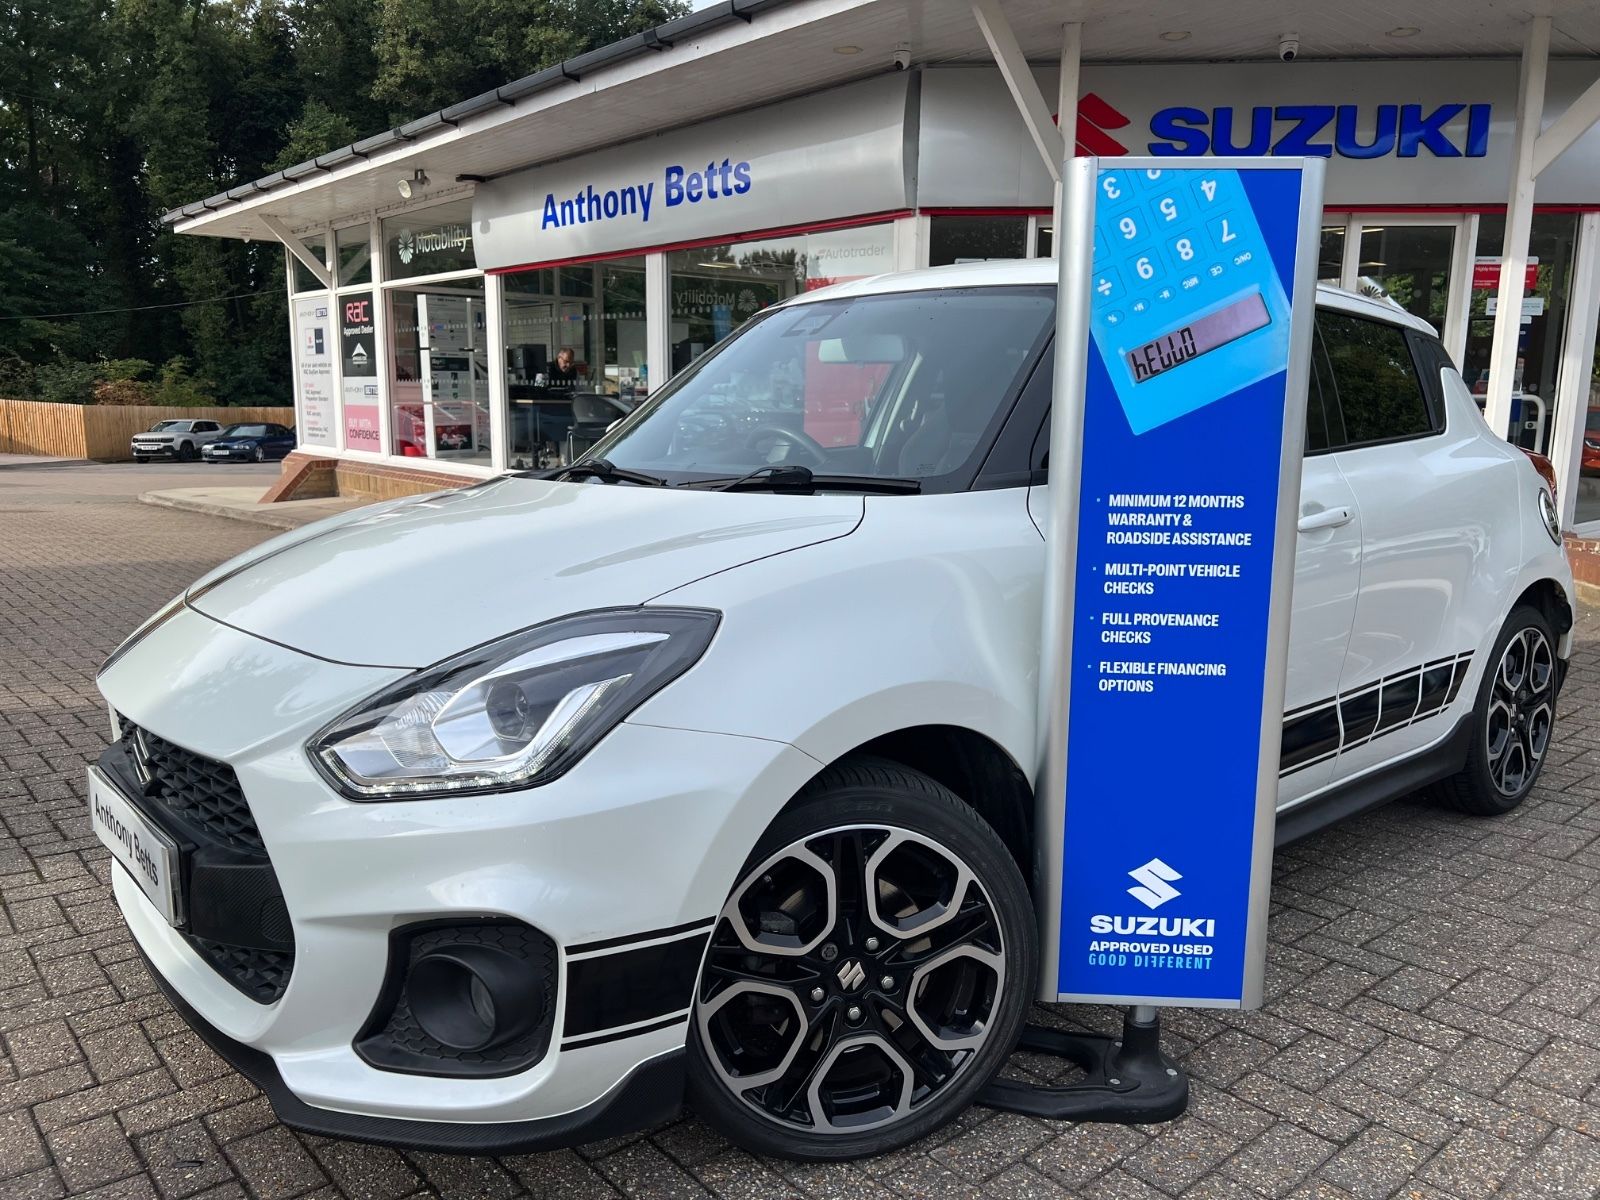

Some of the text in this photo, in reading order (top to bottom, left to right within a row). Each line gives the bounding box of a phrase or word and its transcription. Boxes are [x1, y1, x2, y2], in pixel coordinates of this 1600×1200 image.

[1148, 104, 1491, 159] SUZUKI
[542, 158, 752, 229] Anthony Betts
[416, 225, 468, 253] Motability
[825, 244, 886, 260] Autotrader
[1176, 238, 1194, 261] 8
[343, 327, 361, 337] Approved
[1108, 494, 1245, 508] MINIMUM 12 MONTHS
[1108, 513, 1193, 527] WARRANTY &
[1106, 532, 1252, 546] ROADSIDE ASSISTANCE
[1105, 563, 1240, 577] MULTI-POINT VEHICLE
[1104, 581, 1154, 595] CHECKS
[1102, 613, 1220, 627] FULL PROVENANCE
[1101, 631, 1152, 644] CHECKS
[1099, 662, 1227, 676] FLEXIBLE FINANCING
[1098, 679, 1154, 693] OPTIONS
[95, 793, 159, 887] Anthony Betts
[1090, 914, 1215, 938] SUZUKI
[1089, 941, 1213, 955] APPROVED USED
[1088, 953, 1127, 967] GOOD
